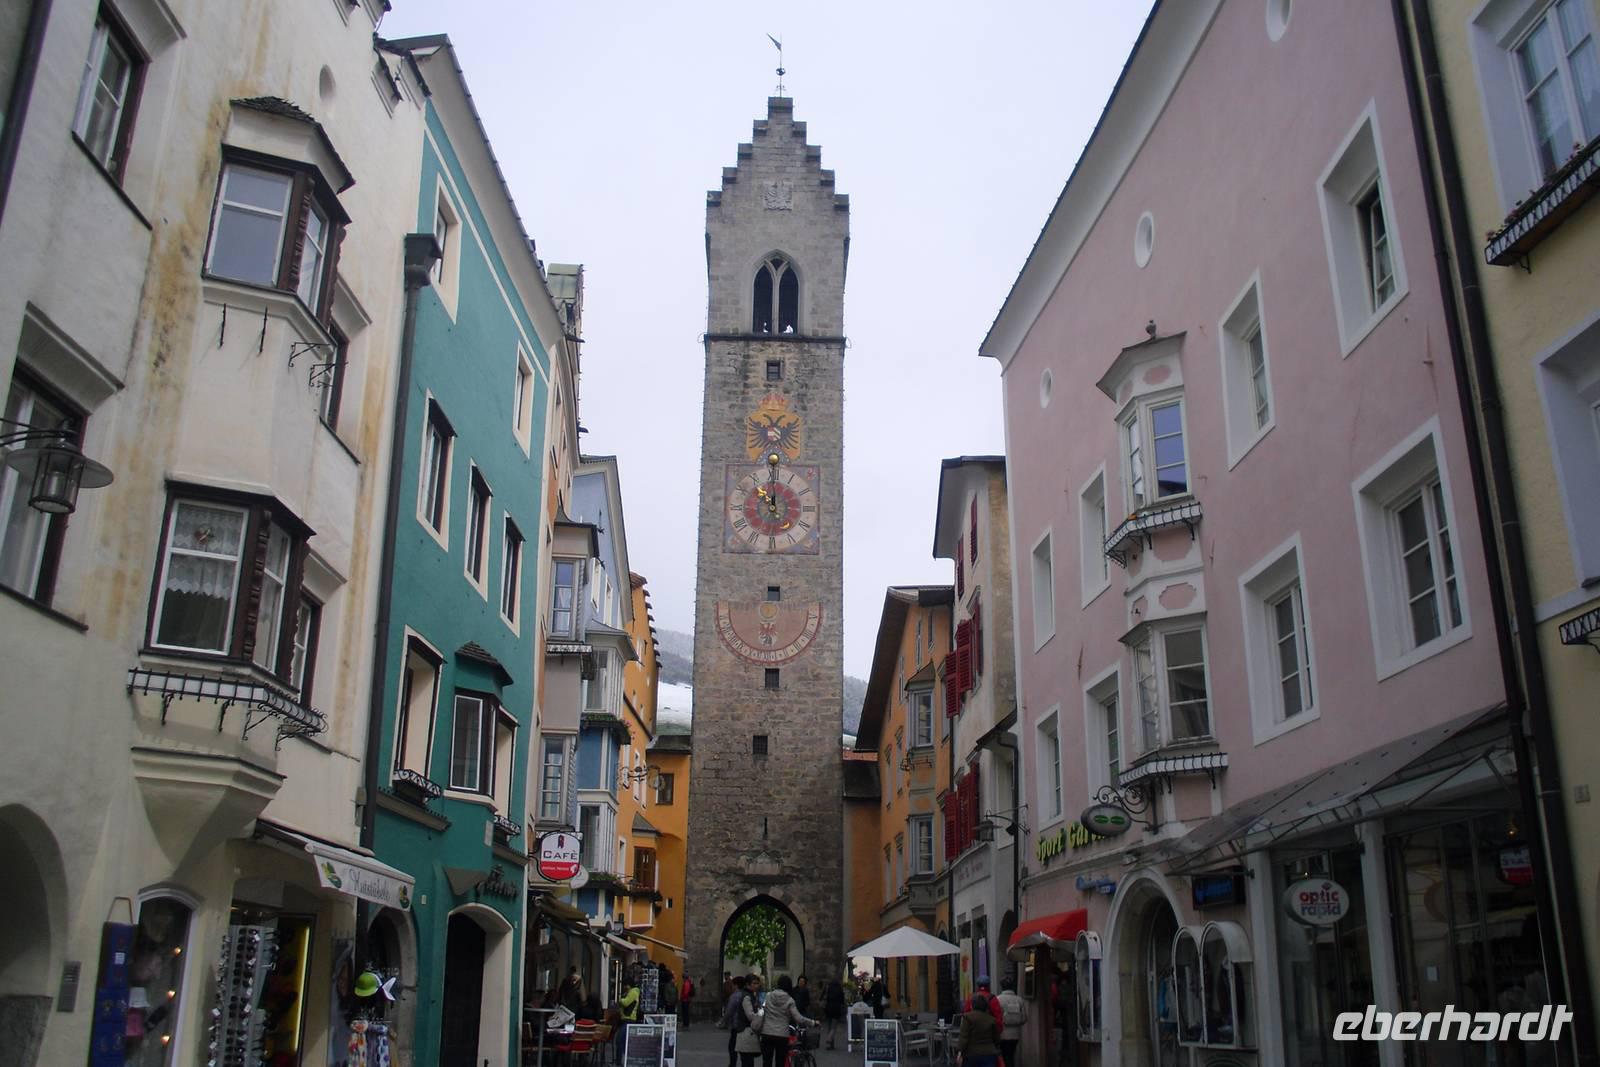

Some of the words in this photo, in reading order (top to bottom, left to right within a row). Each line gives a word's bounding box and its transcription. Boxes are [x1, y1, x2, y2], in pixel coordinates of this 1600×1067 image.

[1035, 827, 1066, 865] Sport
[1299, 886, 1340, 905] optic
[1301, 903, 1342, 919] rapid
